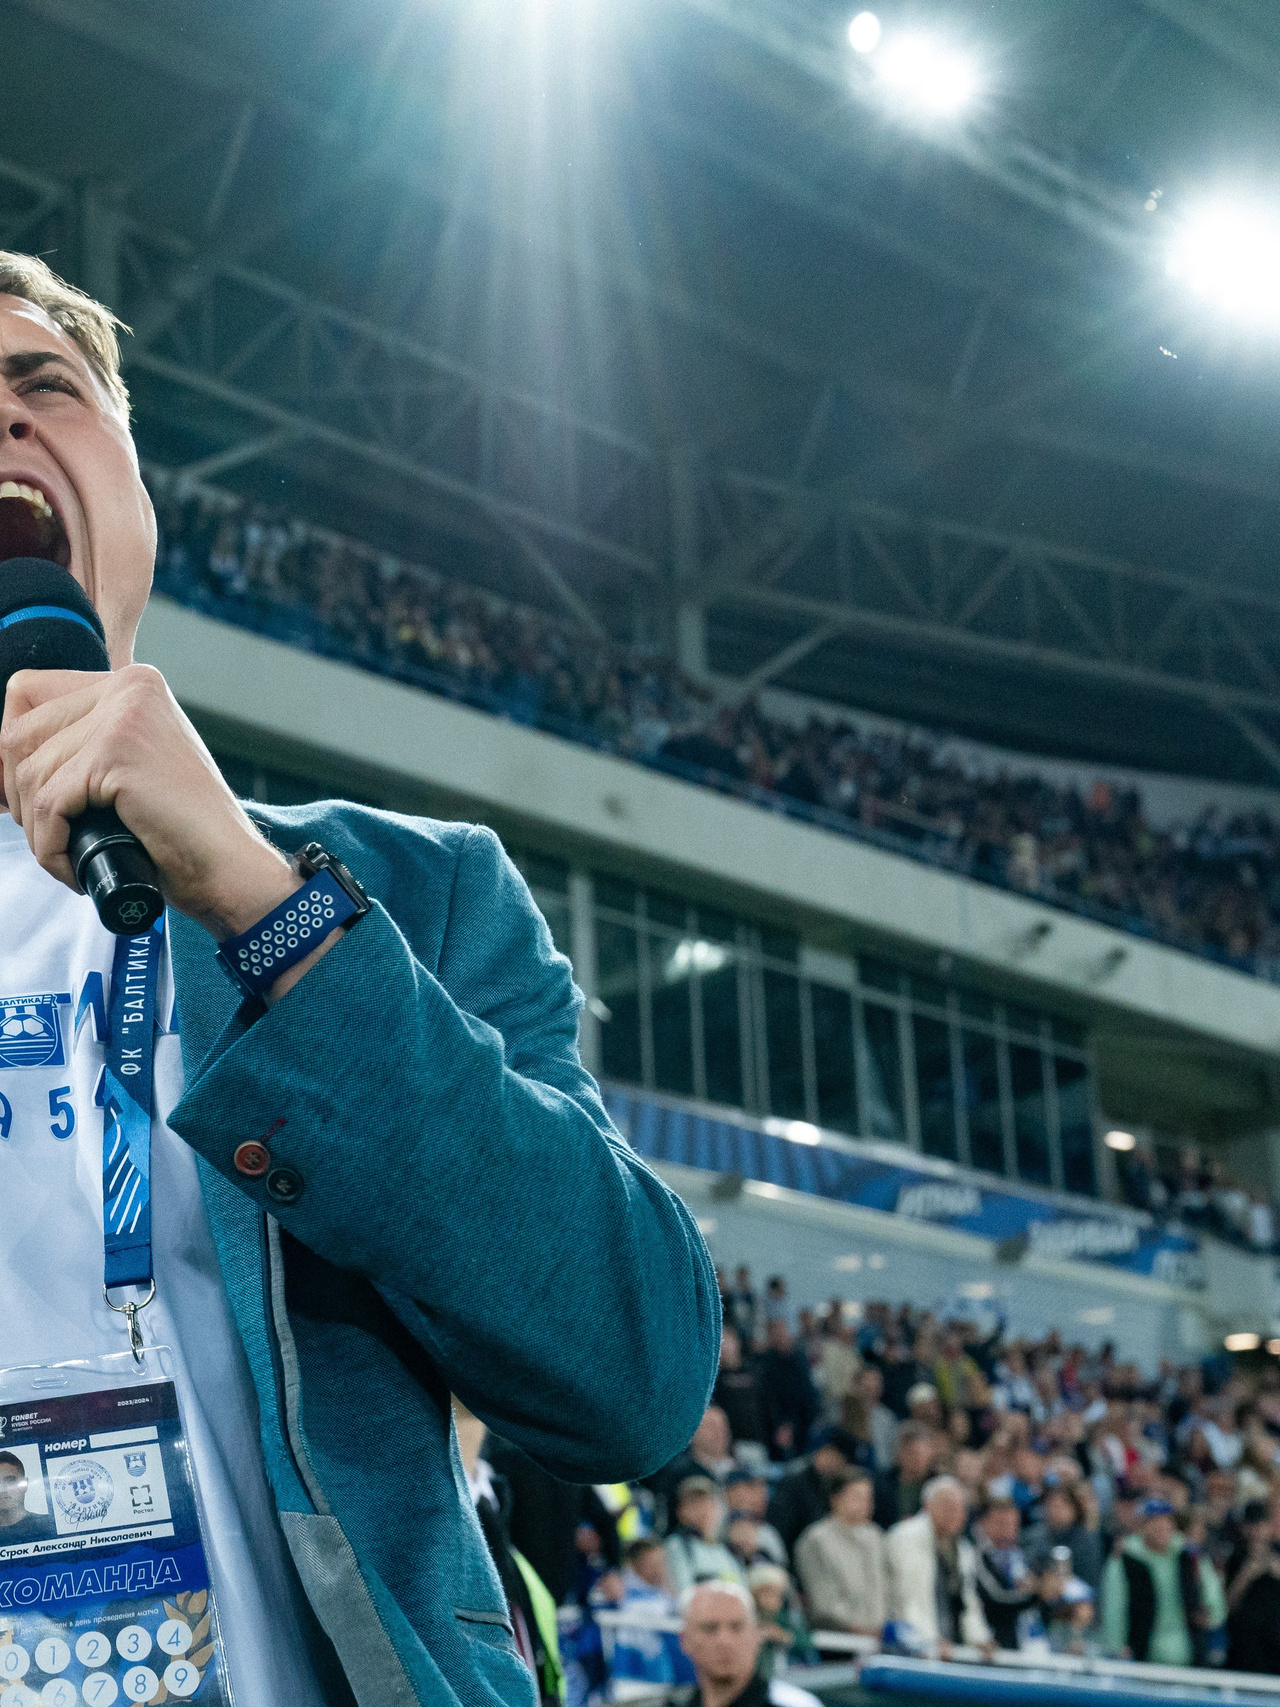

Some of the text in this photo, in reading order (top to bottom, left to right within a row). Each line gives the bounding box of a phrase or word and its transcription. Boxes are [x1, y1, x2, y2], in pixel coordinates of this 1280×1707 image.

[121, 1048, 142, 1075] ФК
[10, 1412, 39, 1422] FONBET
[44, 1438, 88, 1453] номер
[133, 1507, 155, 1515] Ростех
[0, 1529, 153, 1559] Строк Александр Николаевич
[75, 1619, 91, 1627] день
[93, 1611, 136, 1624] проведения
[137, 1607, 159, 1617] матча
[4, 1626, 180, 1672] 0 1 2 3 4
[53, 1685, 67, 1706] 6
[93, 1679, 107, 1701] 7
[134, 1673, 147, 1694] 8
[174, 1667, 188, 1689] 9
